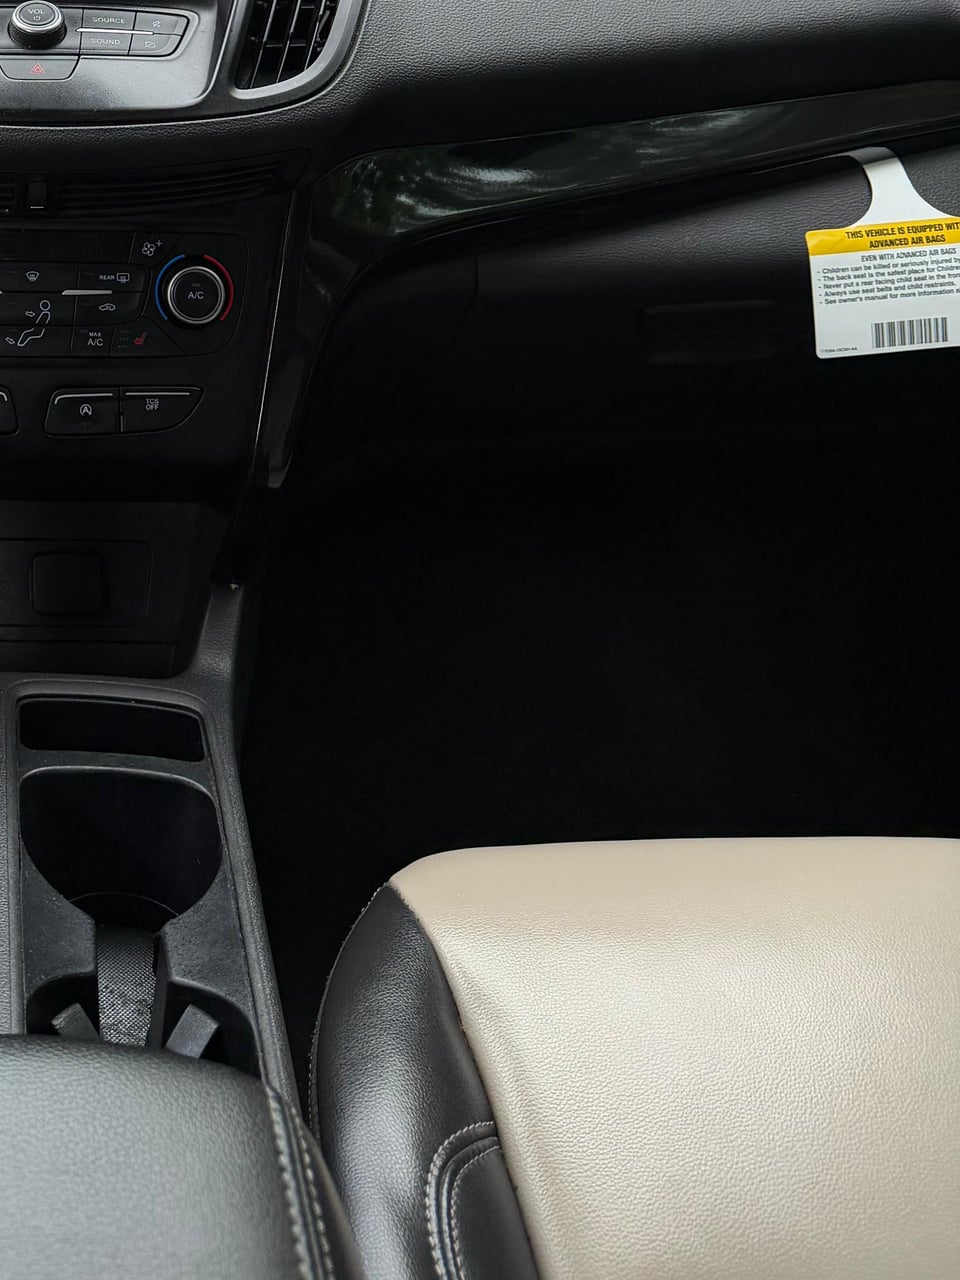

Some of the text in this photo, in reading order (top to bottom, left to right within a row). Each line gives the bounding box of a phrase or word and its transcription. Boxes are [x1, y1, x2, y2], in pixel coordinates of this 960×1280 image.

[845, 230, 863, 240] THIS
[865, 228, 896, 238] VEHICLE
[898, 226, 905, 234] IS
[907, 223, 943, 234] EQUIPPED
[869, 234, 946, 248] ADVANCED AIR BAGS
[896, 250, 927, 259] ADVANCED
[187, 290, 204, 300] A/C
[87, 337, 104, 347] A/C
